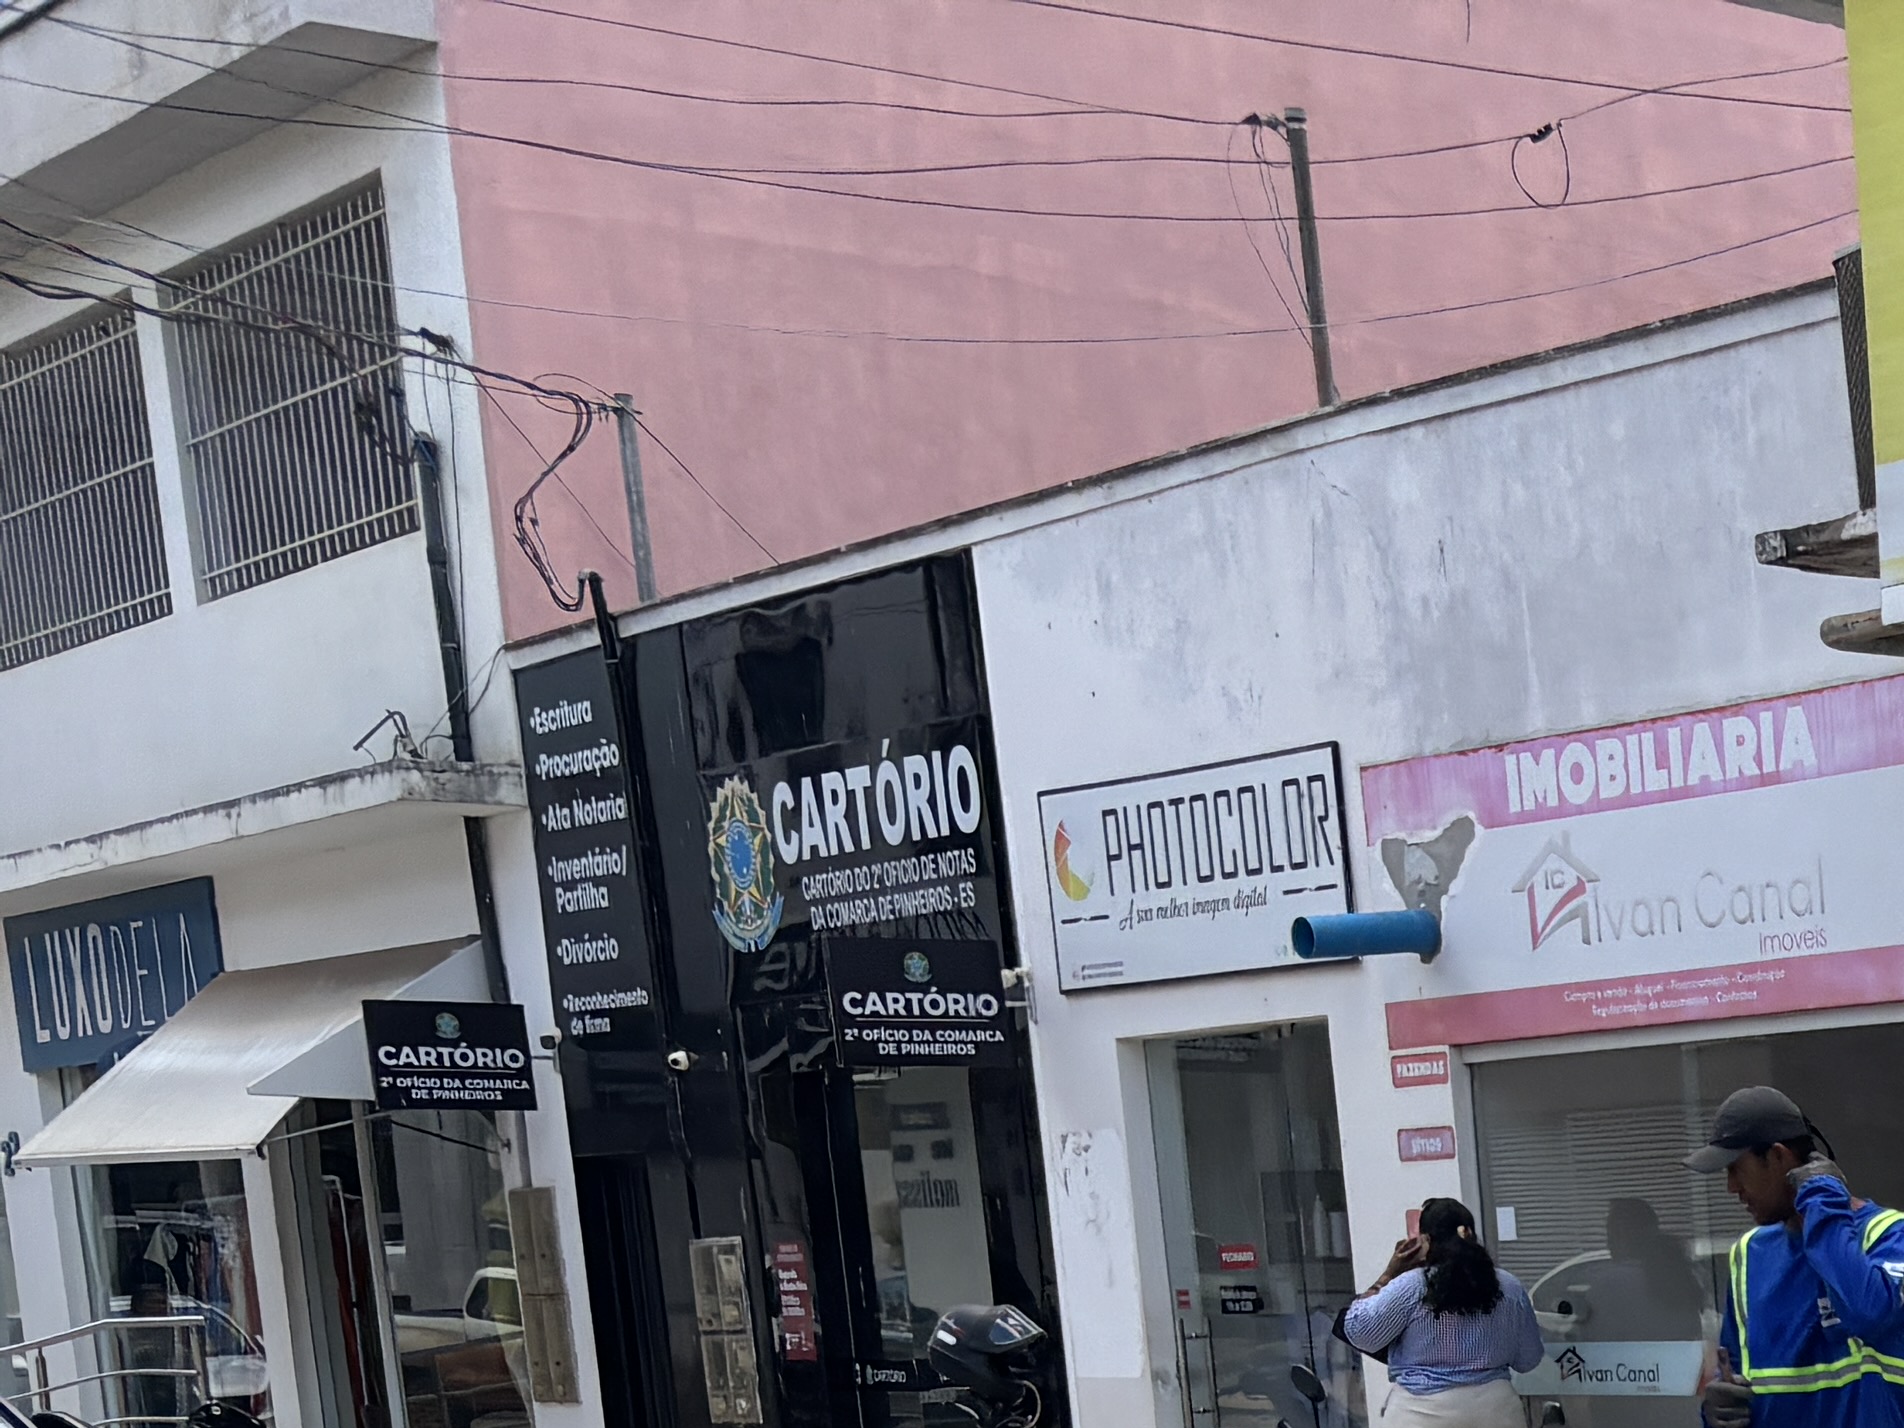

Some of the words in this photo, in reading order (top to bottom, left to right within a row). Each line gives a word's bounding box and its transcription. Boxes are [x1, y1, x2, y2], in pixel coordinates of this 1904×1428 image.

[533, 700, 593, 735] Escritura
[539, 738, 620, 781] Procuração
[1504, 704, 1818, 814] IMOBILIARIA
[547, 803, 572, 832] Ata
[772, 738, 981, 866] CARTÓRIO
[1101, 773, 1334, 897] PHOTOCOLOR
[802, 866, 853, 901] CARTÓRIO
[855, 865, 871, 892] DO
[921, 854, 938, 880] DE
[938, 847, 977, 878] NOTAS
[555, 882, 610, 914] Partilha
[810, 905, 827, 931] DA
[827, 895, 879, 929] COMARCA
[878, 894, 895, 921] DE
[894, 885, 953, 920] PINHEIROS
[959, 881, 976, 908] ES
[1233, 884, 1268, 917] digital
[1593, 885, 1683, 942] Ivan
[1694, 853, 1825, 928] Canal
[561, 933, 620, 966] Divórcio
[842, 986, 999, 1017] CARTÓRIO
[862, 1026, 910, 1042] OFÍCIO
[912, 1029, 933, 1042] DA
[935, 1029, 1005, 1042] COMARCA
[878, 1043, 899, 1055] DE
[901, 1043, 976, 1056] PINHEIROS
[378, 1042, 525, 1069] CARTÓRIO
[396, 1075, 441, 1088] OFÍCIO
[443, 1078, 463, 1088] DA
[465, 1079, 531, 1090] COMARCA
[411, 1089, 430, 1099] DE
[1583, 1363, 1613, 1383] Ivan
[1615, 1363, 1660, 1383] Canal
